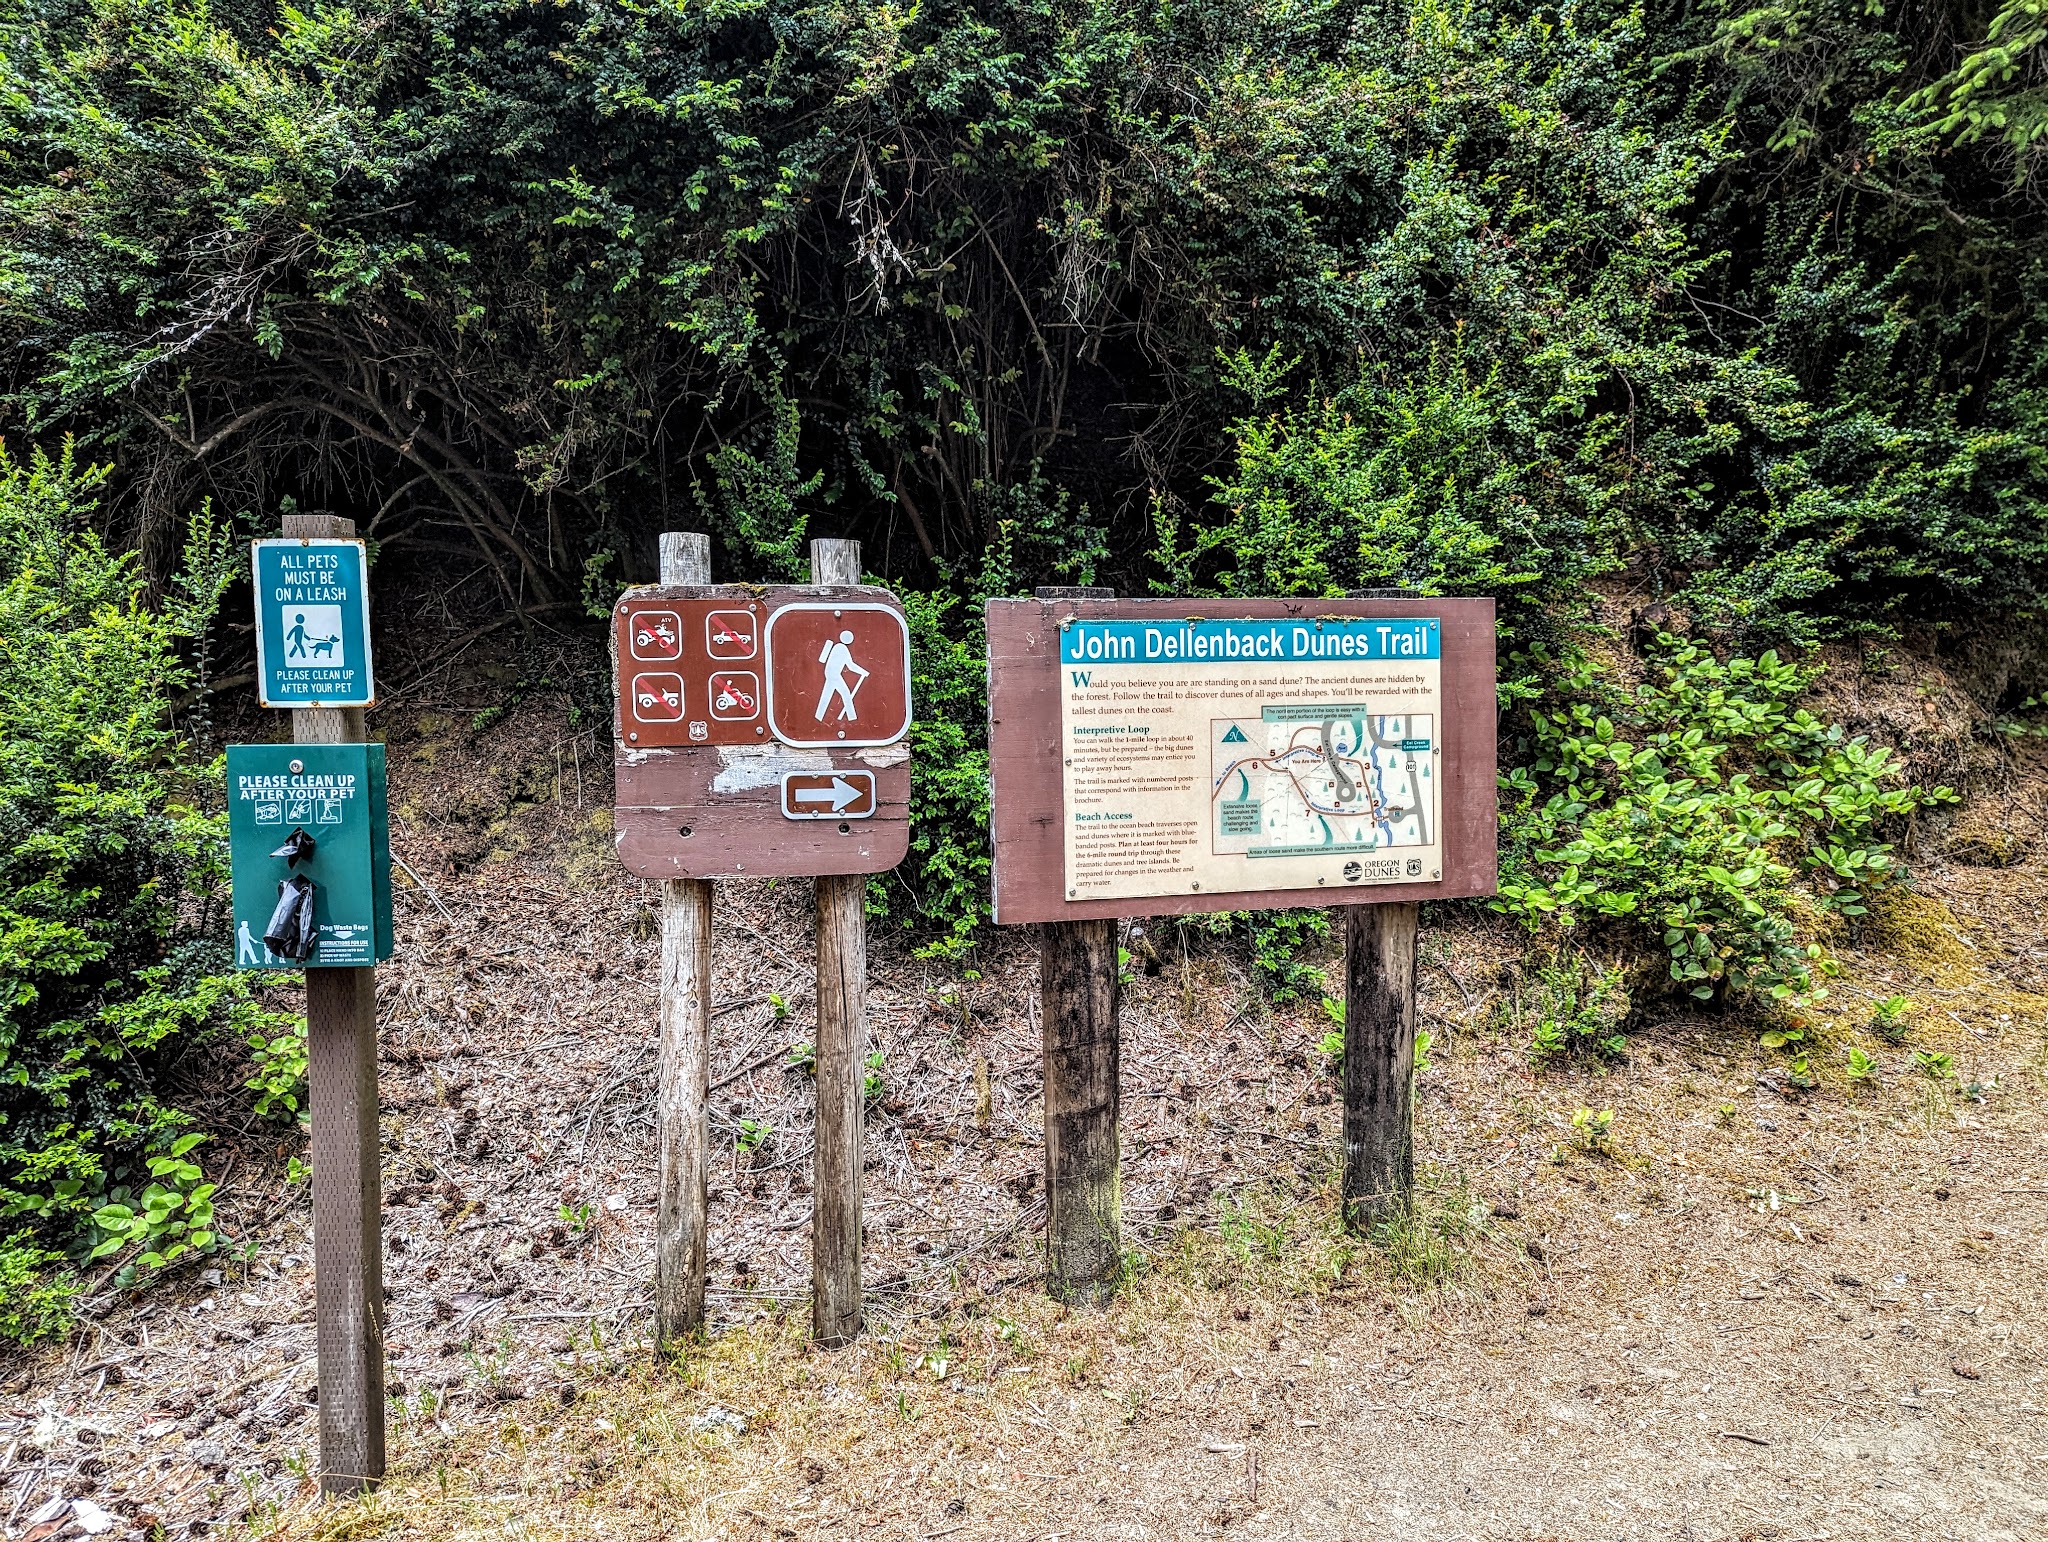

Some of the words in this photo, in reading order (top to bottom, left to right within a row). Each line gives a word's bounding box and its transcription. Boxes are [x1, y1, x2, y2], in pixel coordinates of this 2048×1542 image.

[281, 555, 304, 568] ALL
[308, 555, 338, 568] PETS
[285, 571, 316, 585] MUST
[320, 571, 335, 584] BE
[275, 588, 291, 601] ON
[295, 588, 303, 601] A
[307, 587, 346, 601] LEASH
[1070, 629, 1135, 658] John
[1145, 628, 1284, 657] Dellenback
[1293, 628, 1368, 656] Dunes
[1376, 627, 1428, 654] Trail
[277, 670, 310, 680] PLEASE
[312, 670, 340, 680] CLEAN
[342, 670, 354, 680] UP
[1071, 671, 1108, 688] Would
[1128, 679, 1157, 687] believe
[1204, 678, 1239, 688] standing
[1259, 677, 1277, 685] sand
[1279, 677, 1303, 687] dune?
[1350, 676, 1373, 684] dunes
[1388, 675, 1414, 683] hidden
[1415, 675, 1425, 684] by
[281, 683, 308, 693] AFTER
[310, 683, 333, 693] YOUR
[335, 683, 352, 693] PET
[1071, 693, 1084, 701] the
[1086, 693, 1110, 701] forest.
[1113, 692, 1140, 700] Follow
[1142, 692, 1156, 700] the
[1157, 691, 1173, 699] trail
[1184, 691, 1218, 699] discover
[1219, 690, 1244, 698] dunes
[1245, 689, 1254, 698] of
[1255, 689, 1265, 697] all
[1266, 691, 1284, 699] ages
[1285, 689, 1300, 697] and
[1301, 689, 1329, 698] shapes.
[1365, 687, 1400, 695] rewarded
[1072, 707, 1096, 715] tallest
[1137, 706, 1150, 714] the
[1074, 726, 1125, 736] Interpretive
[1128, 725, 1150, 735] Loop
[1230, 730, 1240, 741] N
[1146, 736, 1160, 744] loop
[1121, 745, 1148, 754] prepared
[1164, 744, 1175, 752] big
[1316, 745, 1322, 753] 4
[239, 776, 288, 787] PLEASE
[291, 775, 334, 788] CLEAN
[337, 775, 355, 786] UP
[240, 789, 284, 800] AFTER
[287, 789, 326, 800] YOUR
[330, 789, 355, 799] PET
[1075, 813, 1101, 821] Beach
[1364, 867, 1400, 877] DUNES
